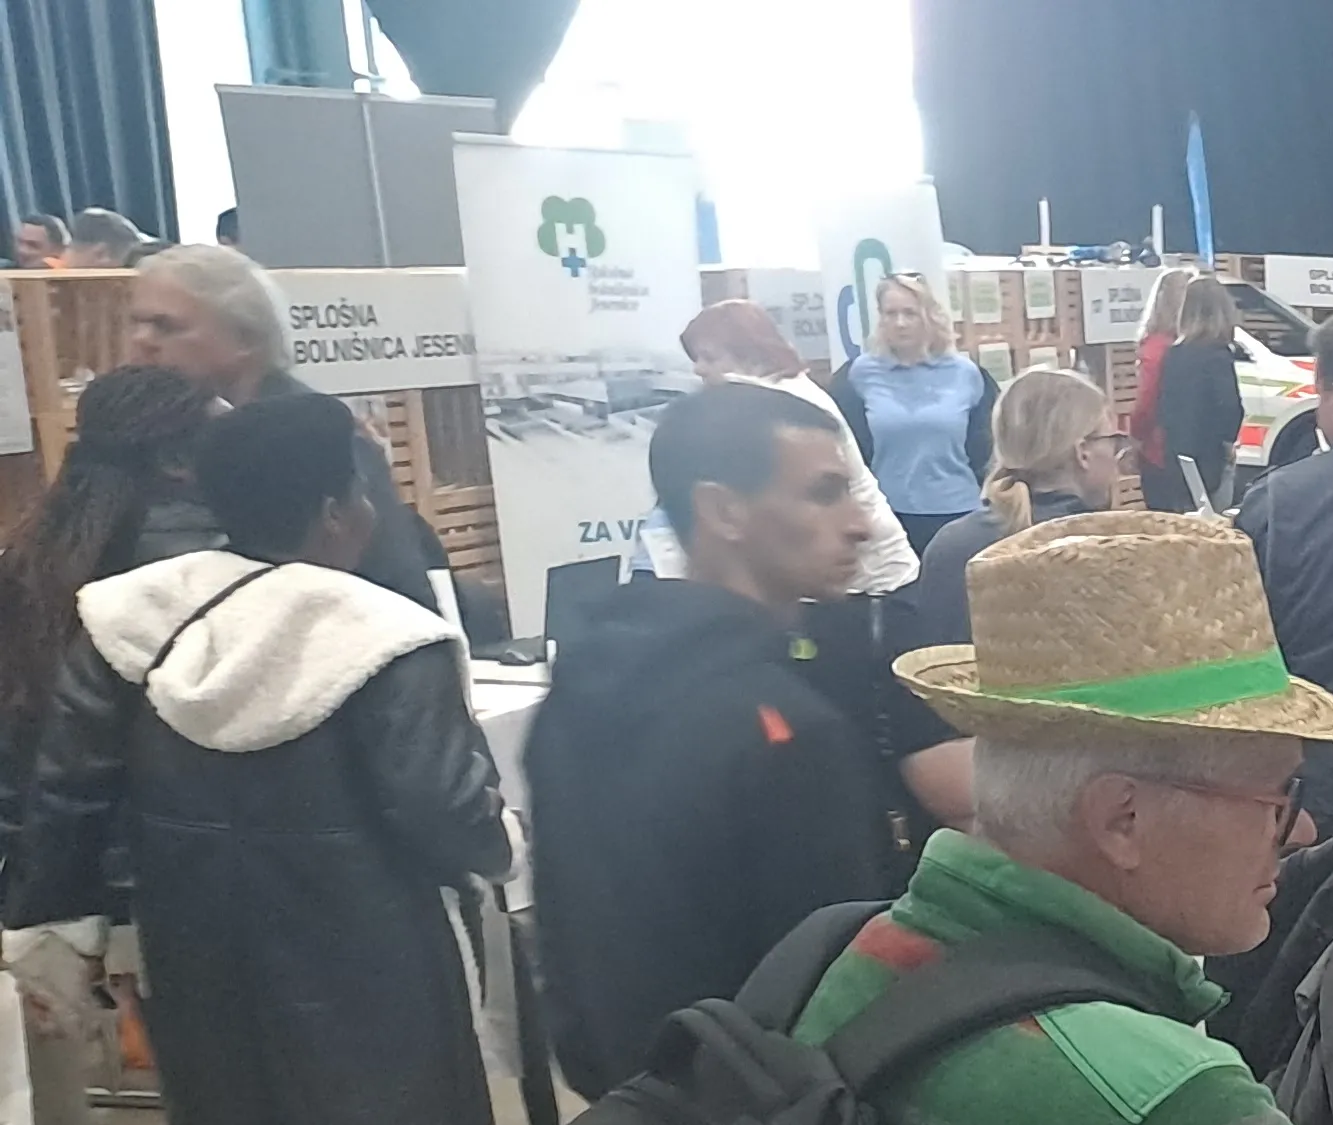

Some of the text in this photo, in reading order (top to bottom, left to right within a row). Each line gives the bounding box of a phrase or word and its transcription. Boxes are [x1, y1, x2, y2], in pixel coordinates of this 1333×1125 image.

[289, 297, 378, 329] SPLOŠNA
[293, 331, 408, 364] BOLNIŠNICA
[578, 521, 612, 543] ZA
